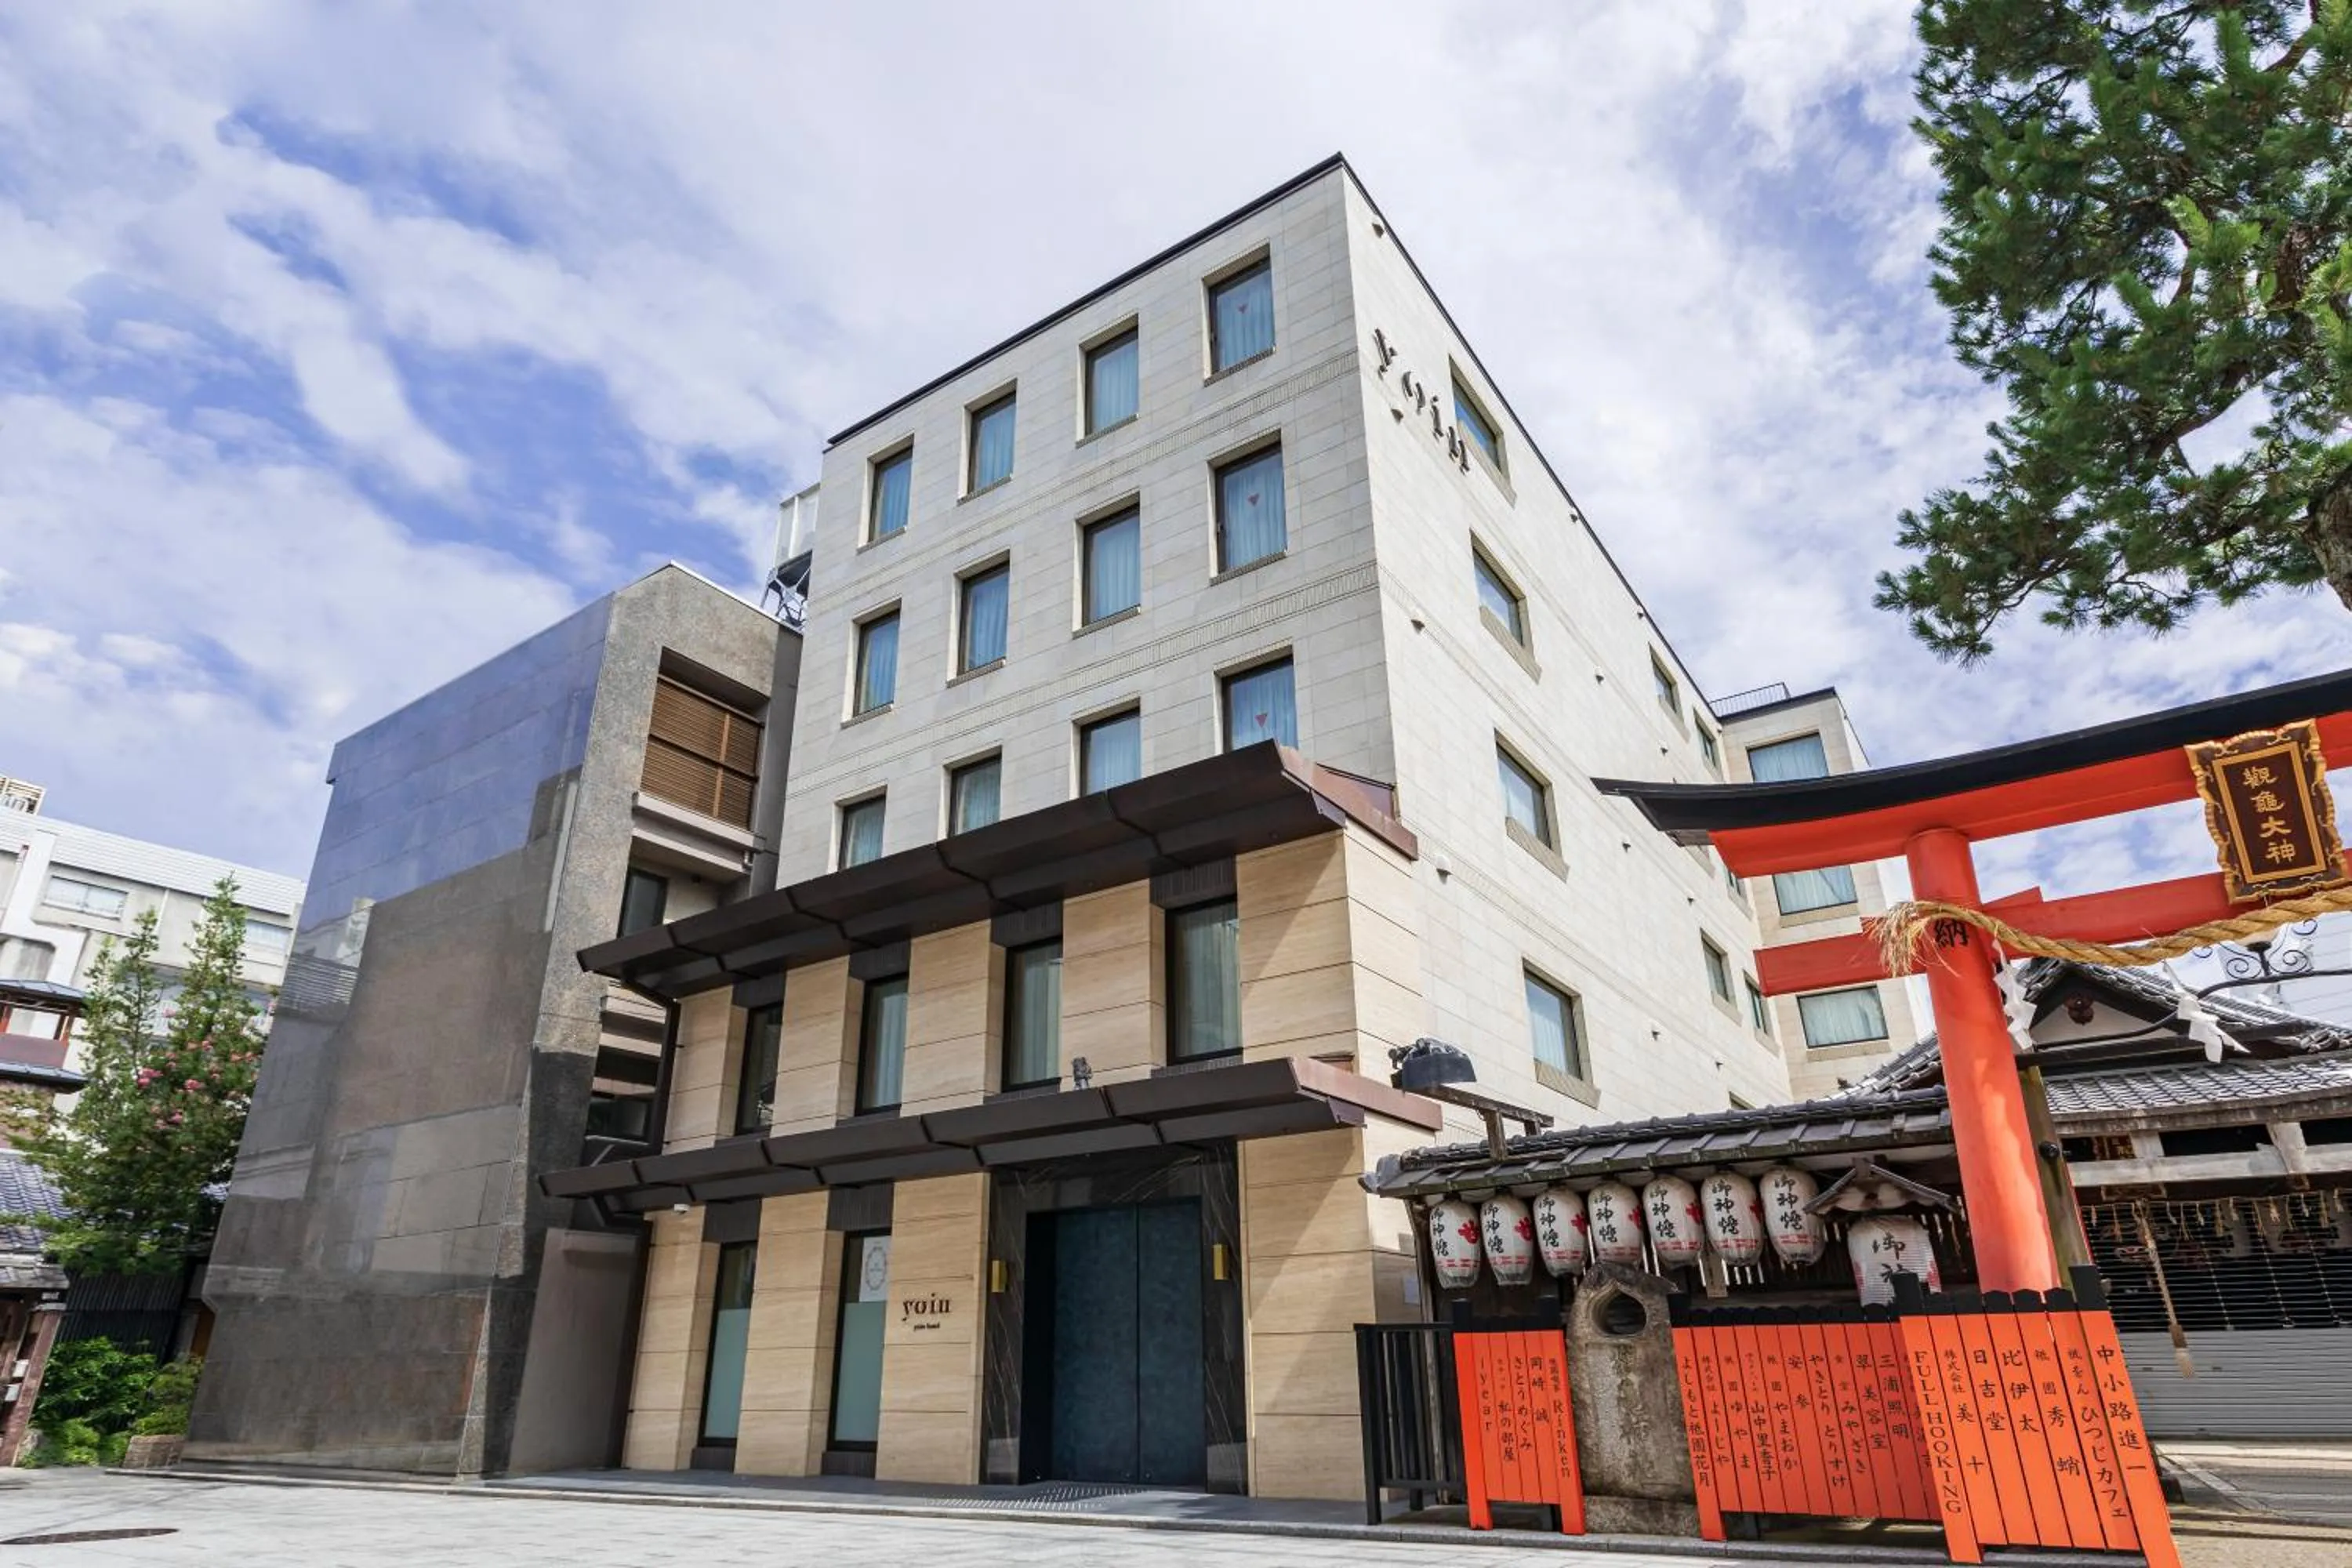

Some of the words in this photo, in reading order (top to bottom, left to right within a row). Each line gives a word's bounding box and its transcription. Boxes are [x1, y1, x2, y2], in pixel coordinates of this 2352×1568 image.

[901, 1293, 951, 1323] yoin
[1514, 1356, 1533, 1451] さとうめぐみ
[1808, 1353, 1831, 1415] やきとり
[1914, 1350, 1939, 1406] FULL
[1973, 1348, 2006, 1432] 日吉堂
[2096, 1344, 2148, 1472] 中小路進一
[1926, 1411, 1962, 1515] HOOKING
[2081, 1406, 2128, 1519] ひつじカフェ
